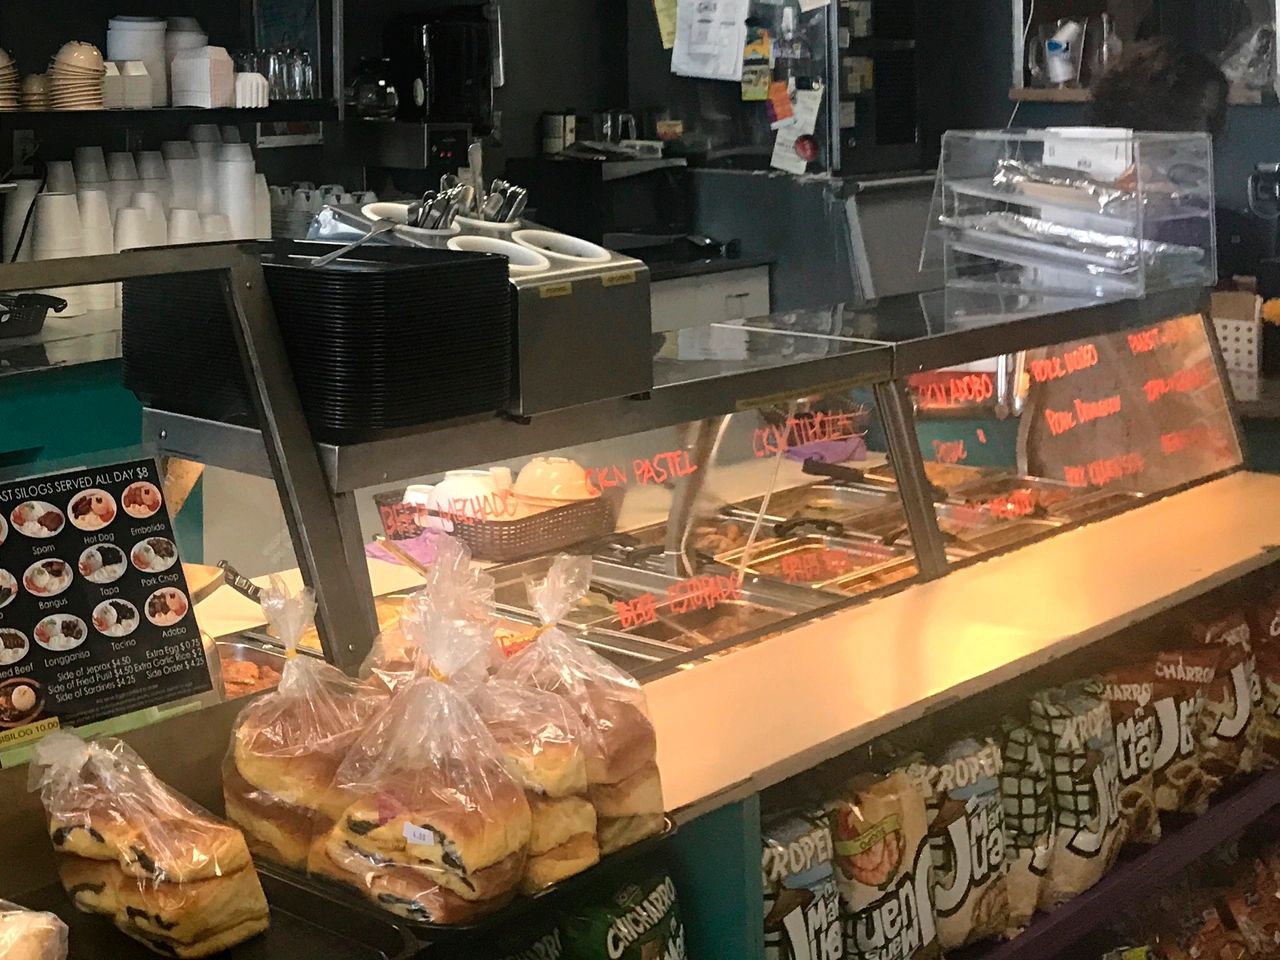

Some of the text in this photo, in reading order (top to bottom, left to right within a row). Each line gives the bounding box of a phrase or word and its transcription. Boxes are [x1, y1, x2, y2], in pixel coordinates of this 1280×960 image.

[584, 449, 698, 496] CKN PASTEL
[15, 482, 54, 500] SILOGS
[55, 476, 93, 491] SERVED
[95, 474, 111, 485] ALL
[115, 470, 133, 482] DAY
[137, 467, 148, 480] $8
[436, 488, 518, 528] MECHADO
[98, 533, 114, 541] Dog
[32, 544, 55, 555] Spam
[141, 573, 179, 587] Pork Chop
[100, 586, 119, 596] Tapa
[39, 599, 68, 610] Bangus
[162, 627, 186, 638] Adobo
[44, 650, 90, 668] Longganisa
[15, 663, 34, 675] Beef
[35, 721, 58, 733] 10.00
